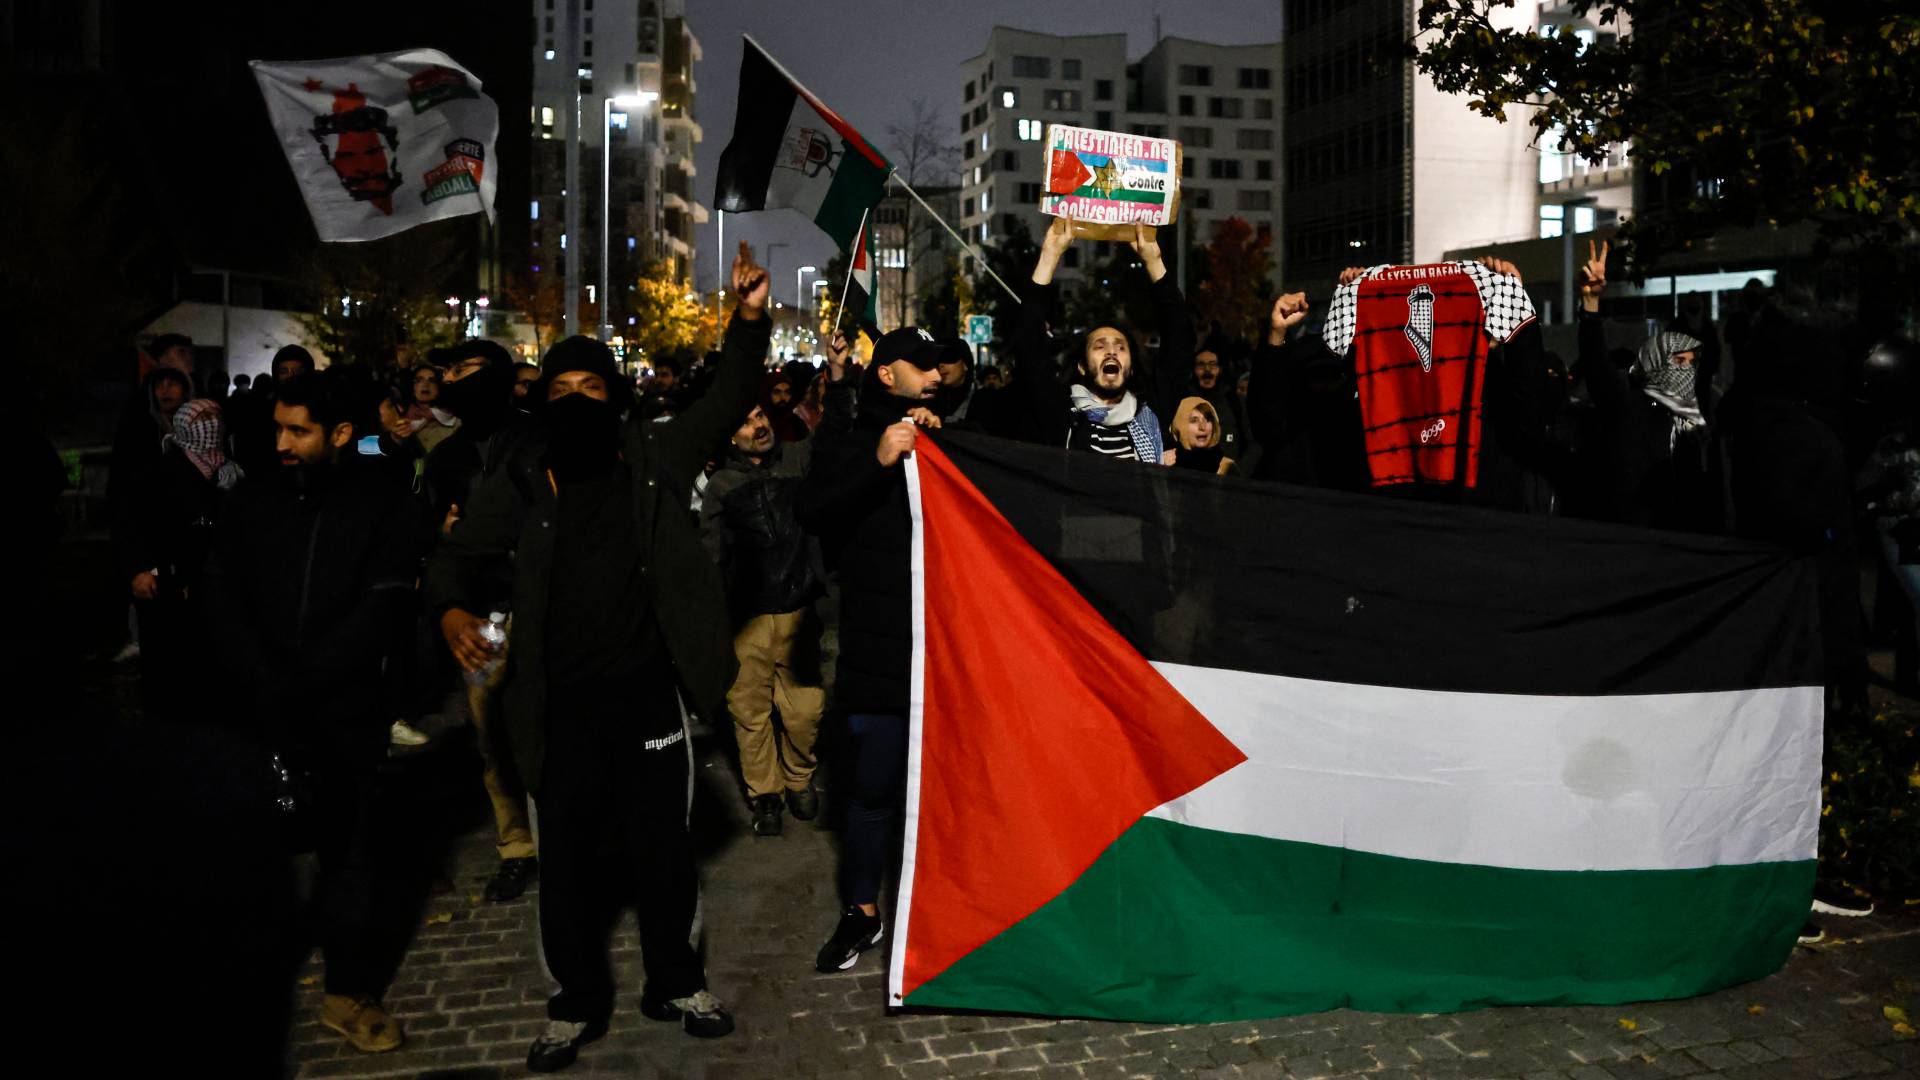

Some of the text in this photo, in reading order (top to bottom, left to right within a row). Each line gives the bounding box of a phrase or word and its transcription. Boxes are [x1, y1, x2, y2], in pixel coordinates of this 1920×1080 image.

[1368, 265, 1462, 282] ALL EYES ON RAFAH
